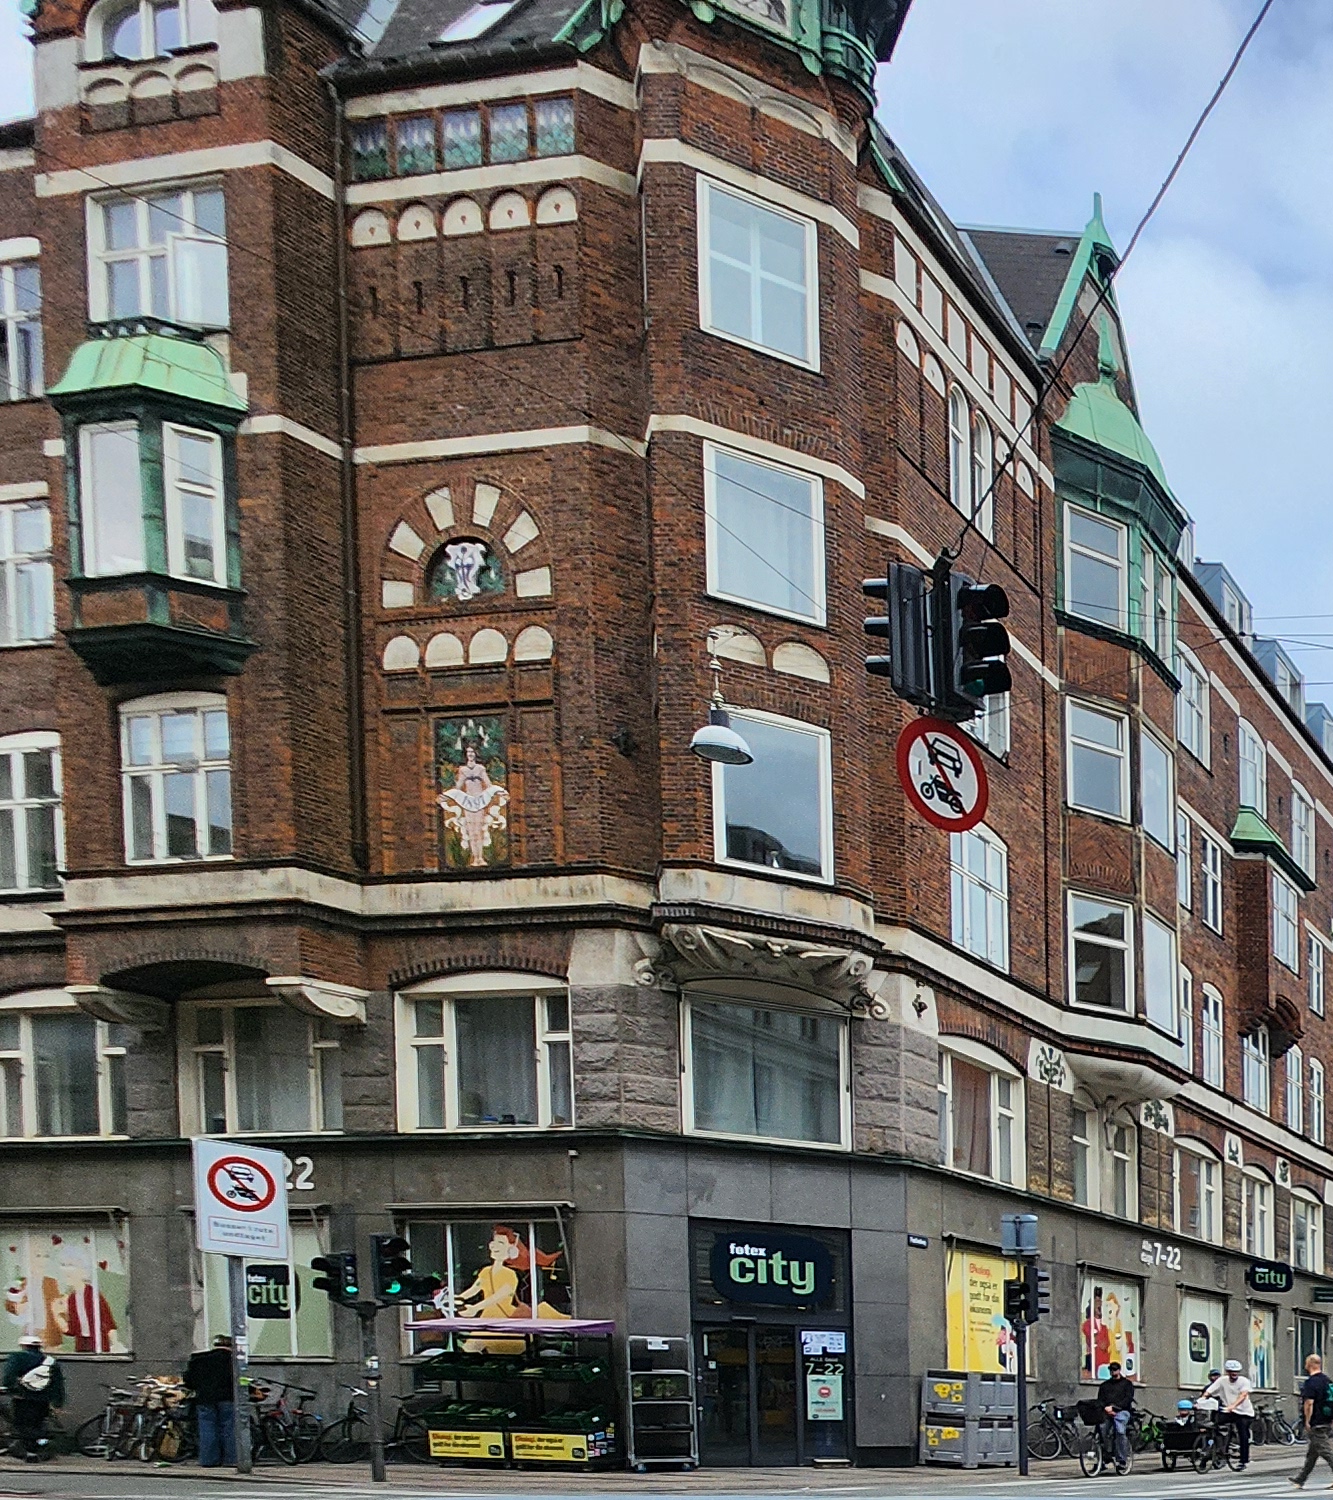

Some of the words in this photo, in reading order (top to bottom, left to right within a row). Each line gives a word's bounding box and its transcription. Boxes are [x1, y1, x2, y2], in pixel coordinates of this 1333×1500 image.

[1154, 1242, 1181, 1271] 7-22
[729, 1251, 815, 1295] city
[1255, 1270, 1287, 1288] city
[248, 1279, 290, 1311] city
[805, 1363, 844, 1376] 7-22
